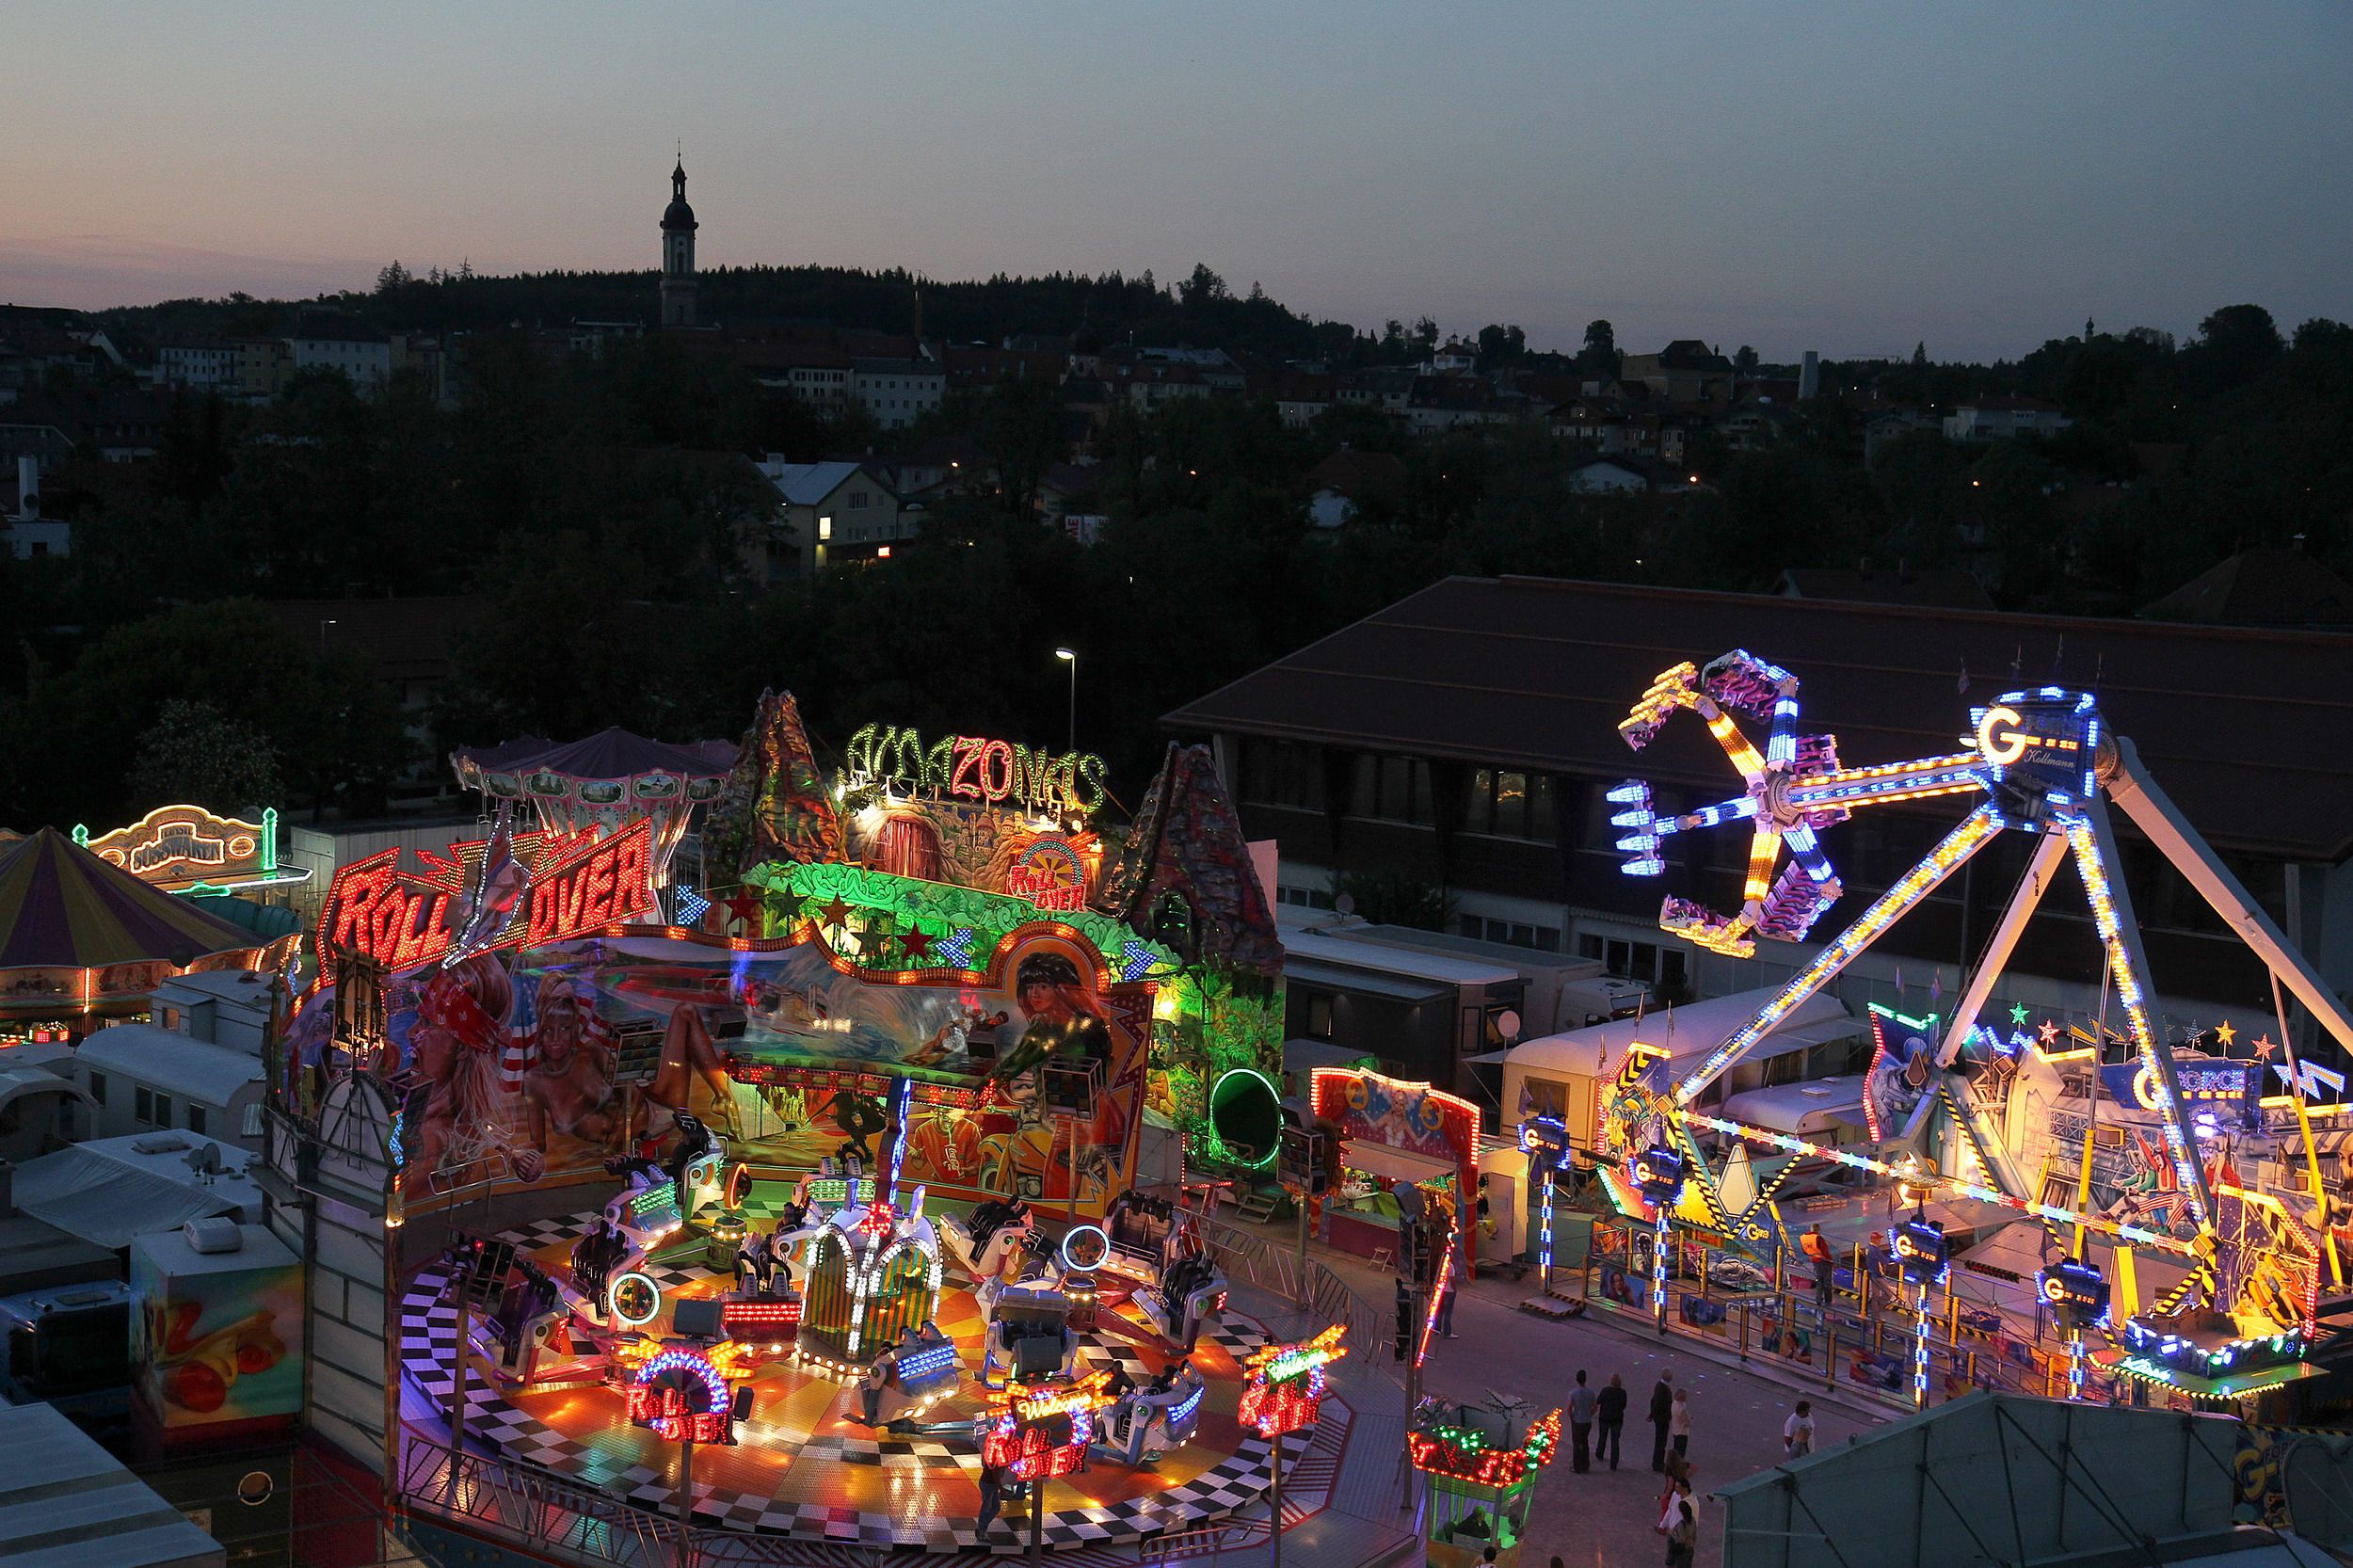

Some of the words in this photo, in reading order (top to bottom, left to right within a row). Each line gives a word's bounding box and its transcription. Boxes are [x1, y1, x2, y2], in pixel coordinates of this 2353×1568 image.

[846, 722, 1109, 814] AMAZONAS
[2024, 749, 2076, 770] Kollmann
[1009, 865, 1057, 896] ROLL
[332, 864, 452, 968] ROLL
[526, 834, 648, 944] OVER
[1034, 885, 1086, 913] OVER
[2175, 1069, 2246, 1093] ORCE
[625, 1384, 690, 1421] ROLL
[1017, 1393, 1093, 1421] Welcome
[661, 1412, 734, 1446] OVER
[984, 1428, 1053, 1470] ROLL
[1016, 1442, 1089, 1481] OVER
